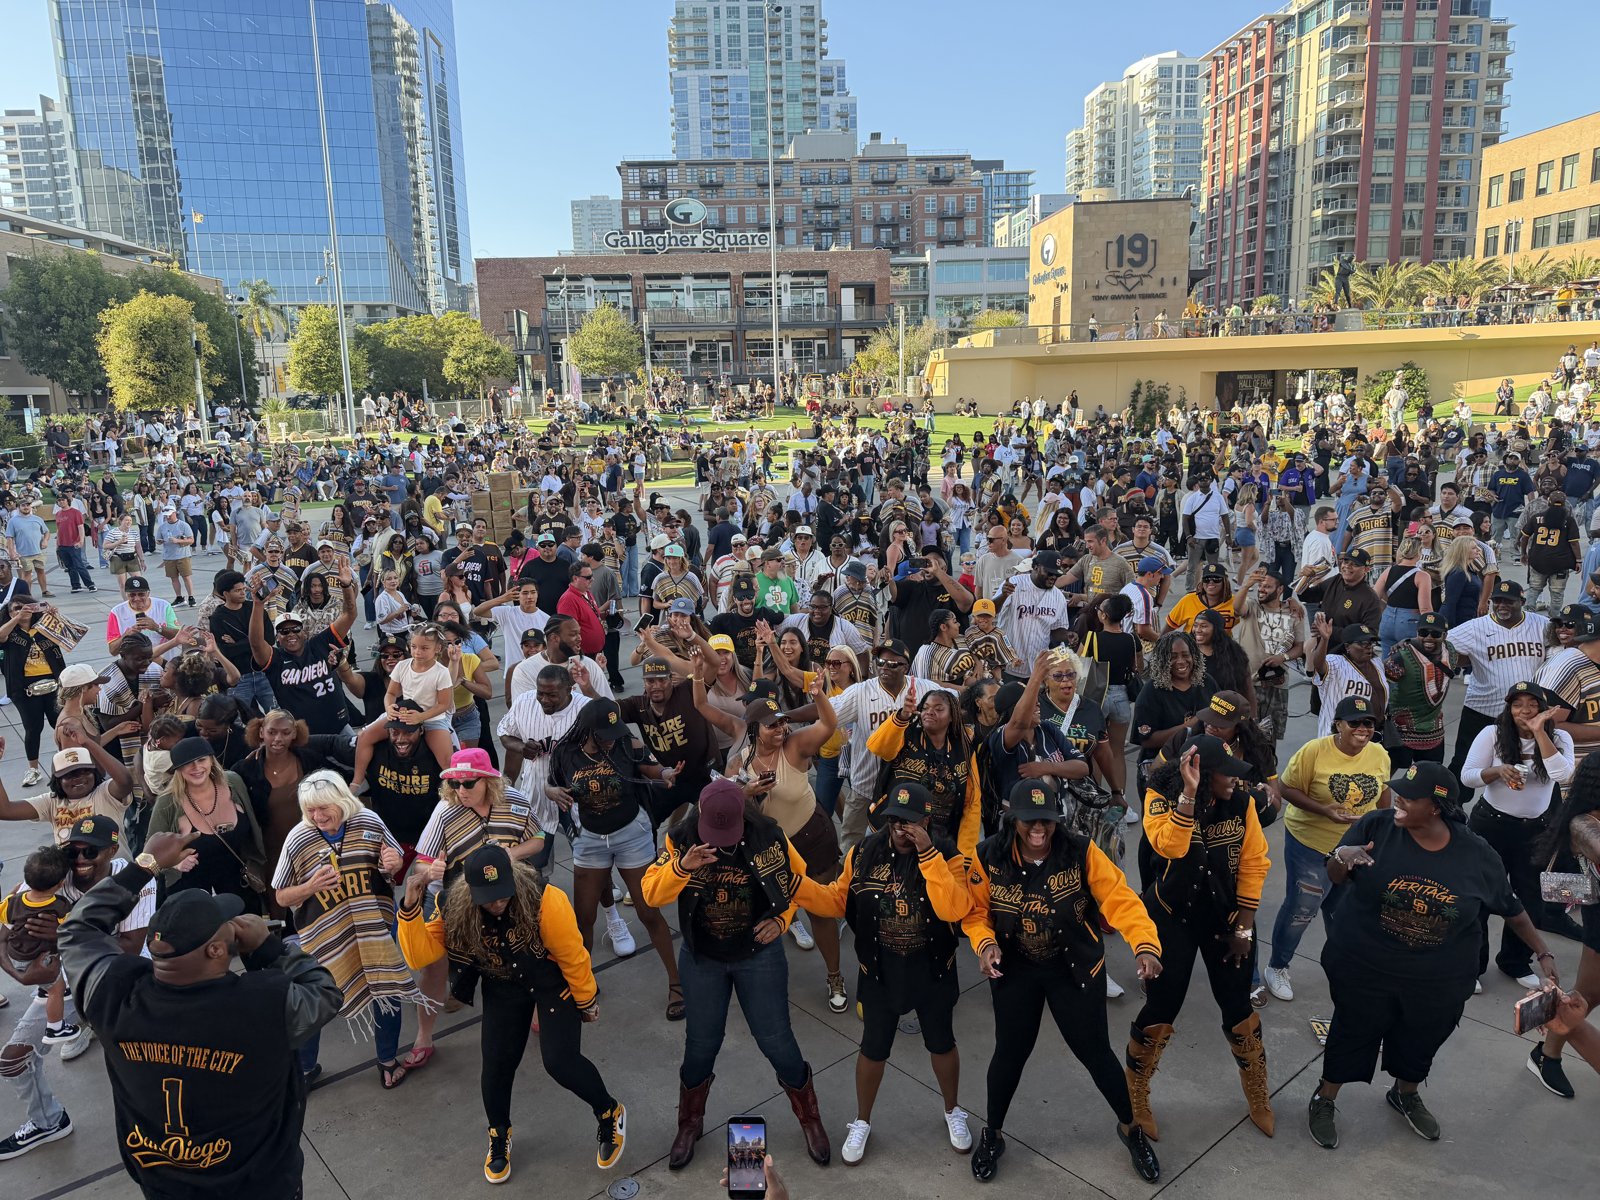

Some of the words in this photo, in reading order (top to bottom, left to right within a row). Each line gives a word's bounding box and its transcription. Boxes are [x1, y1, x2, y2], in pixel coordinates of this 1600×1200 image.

[604, 231, 698, 251] Gallagher
[702, 231, 769, 251] Square
[1115, 233, 1148, 267] 19
[1110, 293, 1136, 301] GWYNN
[1138, 292, 1168, 300] TERRACE
[1239, 379, 1252, 387] HALL
[1261, 379, 1273, 387] FAME
[1536, 527, 1560, 546] 23
[1091, 566, 1104, 586] SD
[1017, 604, 1057, 620] PADRES
[1258, 611, 1291, 630] JUST
[1260, 624, 1284, 641] DO
[1487, 642, 1542, 661] PADRES
[281, 668, 300, 685] SAN
[301, 659, 328, 684] DIEGO
[645, 663, 666, 673] Padres
[313, 677, 335, 697] 23
[1345, 679, 1372, 697] PAD
[1210, 702, 1228, 716] PADRES
[1211, 695, 1220, 703] SAN
[1218, 699, 1235, 711] DIEGO
[649, 729, 688, 752] LIFE
[379, 765, 430, 785] INSPIRE
[572, 766, 616, 780] HERITAGE
[589, 779, 600, 792] SD
[1206, 816, 1244, 841] east
[753, 841, 786, 870] east
[1387, 878, 1459, 904] HERITAGE
[893, 899, 906, 916] SD
[1413, 898, 1428, 914] SD
[1022, 918, 1037, 934] SD
[119, 1041, 142, 1061] THE
[140, 1042, 170, 1063] VOICE
[171, 1044, 186, 1066] OF
[186, 1046, 210, 1070] THE
[209, 1050, 245, 1074] CITY
[162, 1077, 189, 1137] 1
[126, 1124, 164, 1152] San
[161, 1136, 231, 1169] Diego
